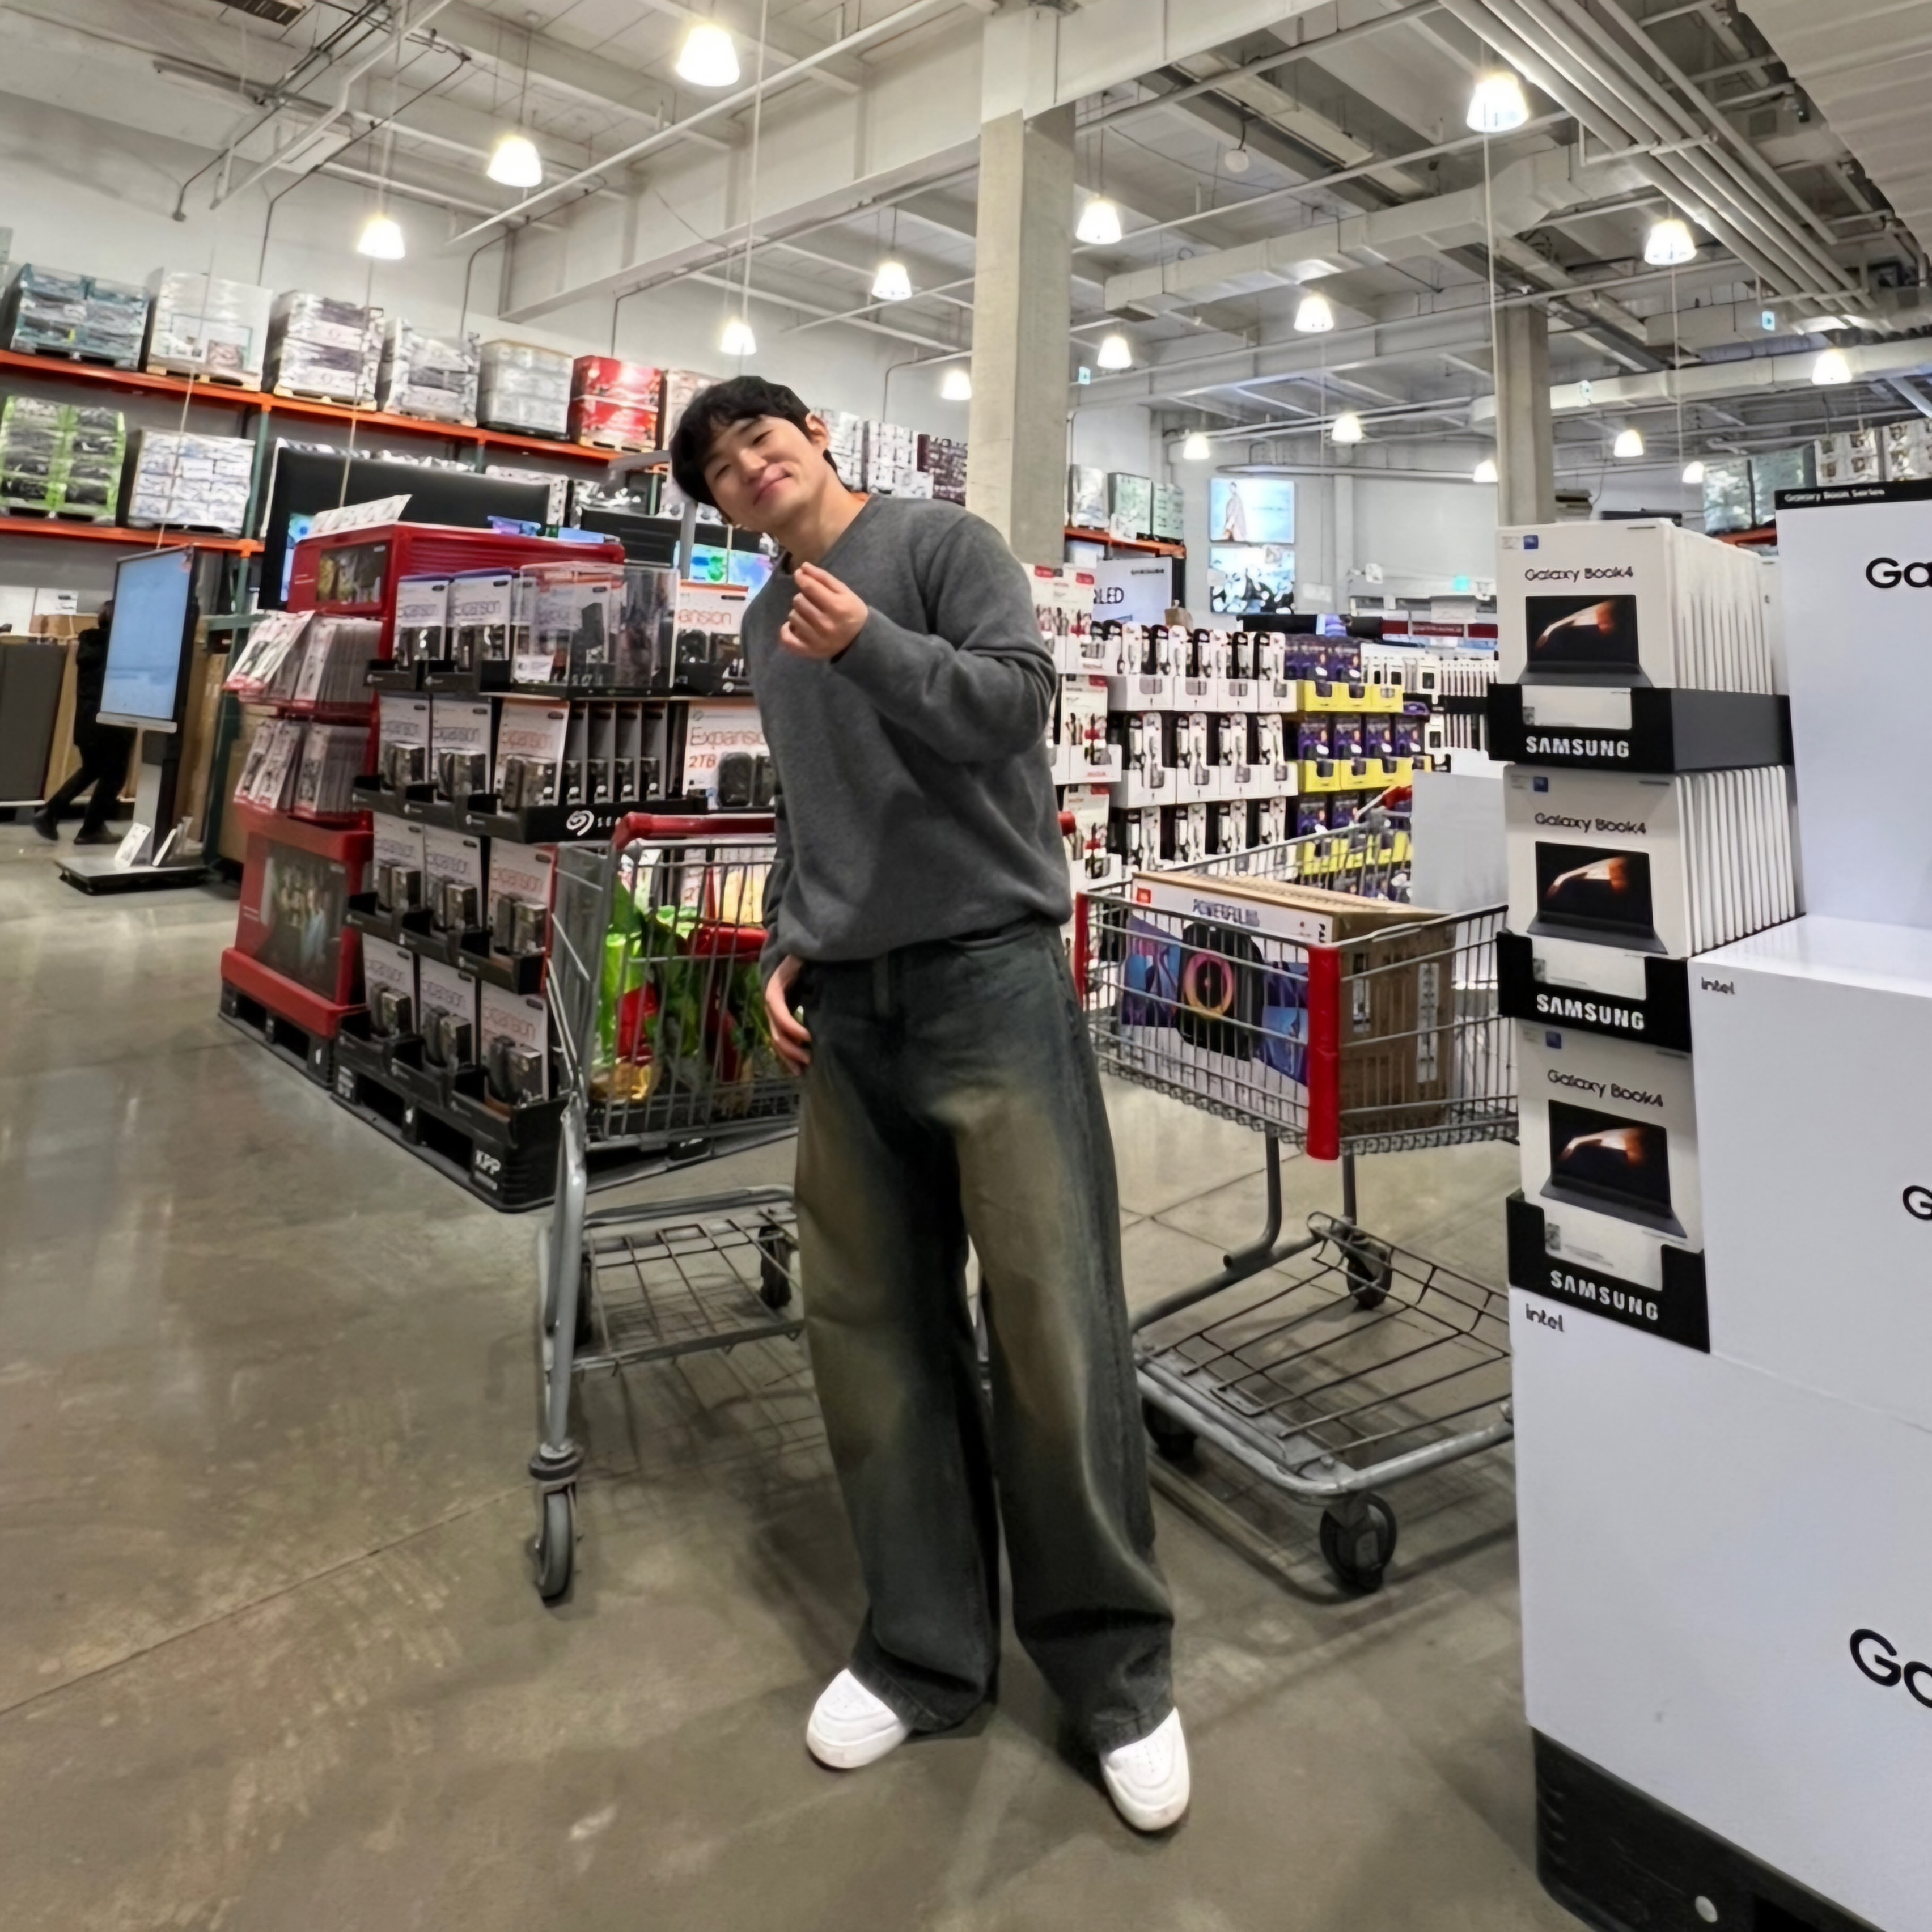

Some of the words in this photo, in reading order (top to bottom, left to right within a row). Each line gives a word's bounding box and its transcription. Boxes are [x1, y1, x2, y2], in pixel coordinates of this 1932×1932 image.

[1524, 568, 1579, 583] Galaxy
[1584, 566, 1634, 579] Book4
[1526, 736, 1630, 759] SAMSUNG
[688, 753, 717, 769] 2TB
[1534, 812, 1591, 833] Galaxy
[1595, 818, 1647, 835] Book4
[1701, 976, 1736, 995] intel
[1536, 994, 1645, 1031] SAMSUNG
[1547, 1069, 1607, 1099] Galaxy
[1610, 1082, 1664, 1107] Book4
[1550, 1269, 1659, 1321] SAMSUNG
[1525, 1303, 1565, 1333] intel
